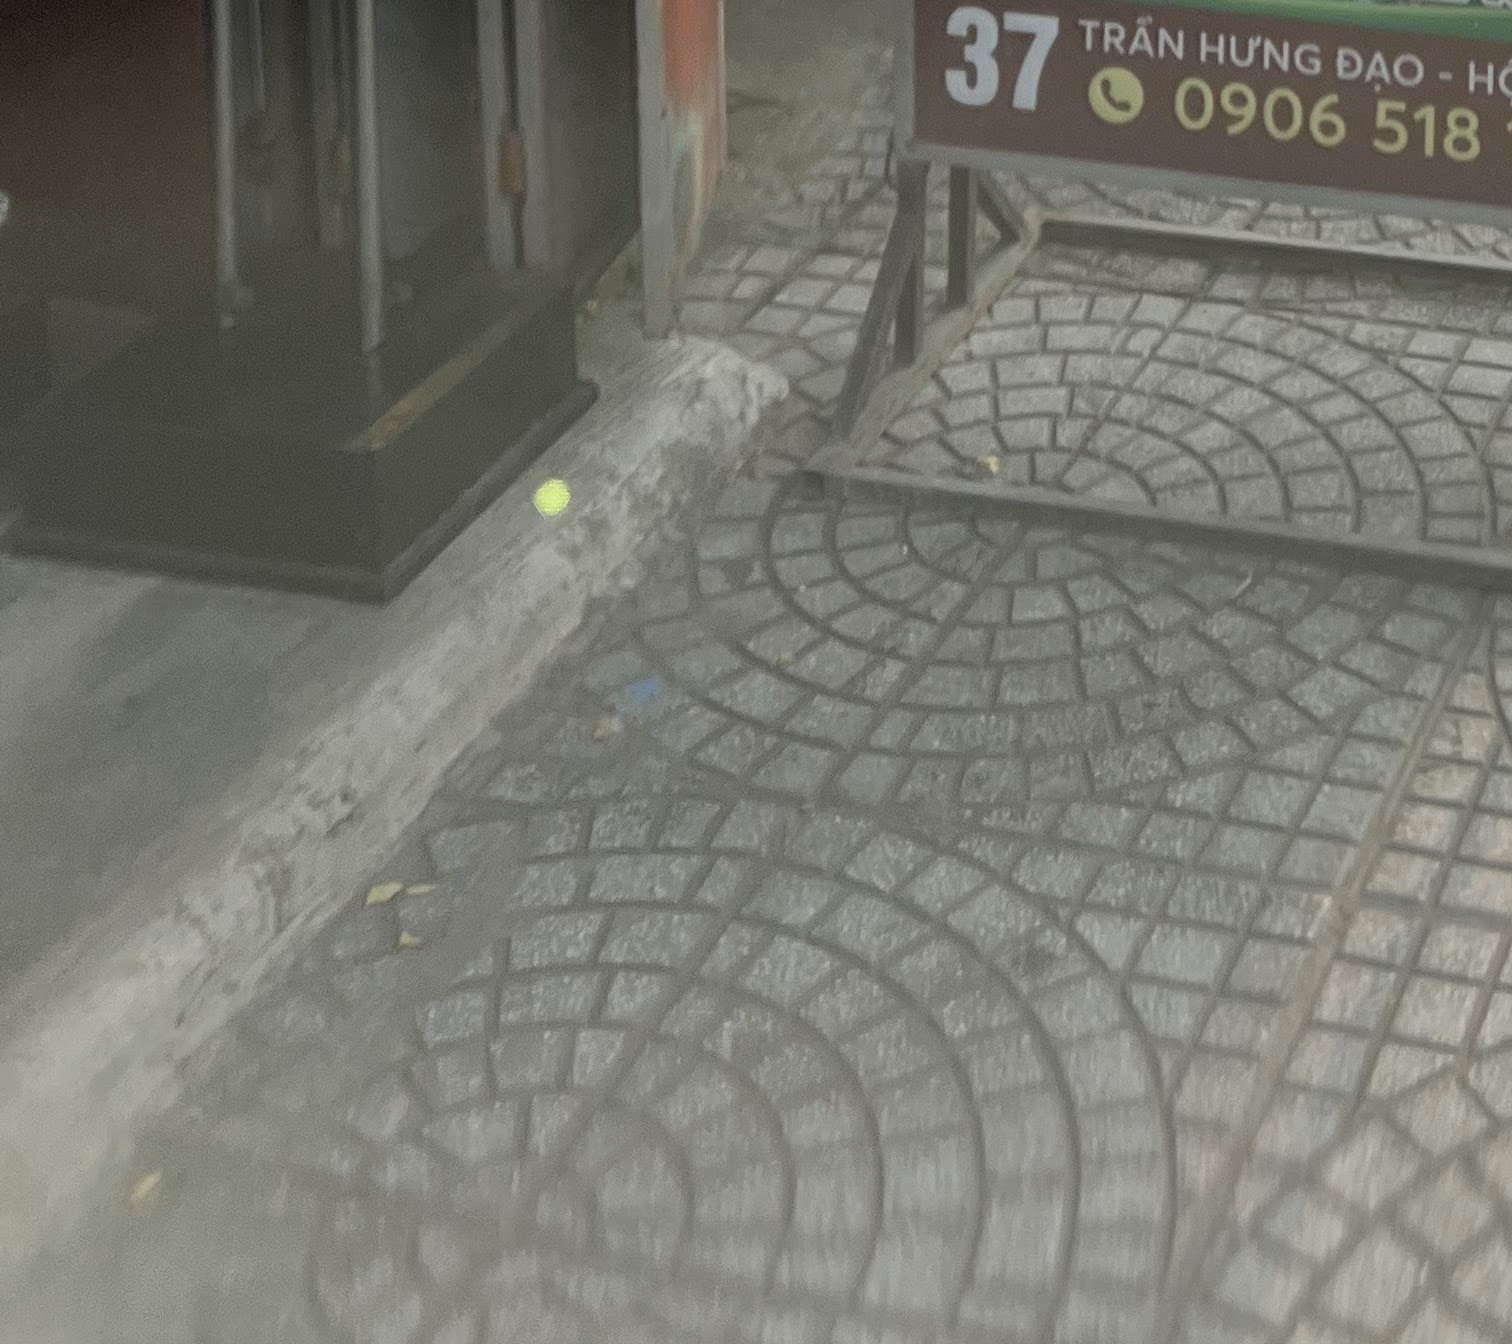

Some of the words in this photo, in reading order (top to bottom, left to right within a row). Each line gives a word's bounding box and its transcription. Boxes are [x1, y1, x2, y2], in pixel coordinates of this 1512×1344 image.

[943, 5, 1061, 114] 37
[1199, 32, 1323, 77] HƯNG
[1336, 50, 1425, 92] ĐẠO
[1174, 76, 1347, 148] 0906
[1373, 99, 1481, 162] 518
